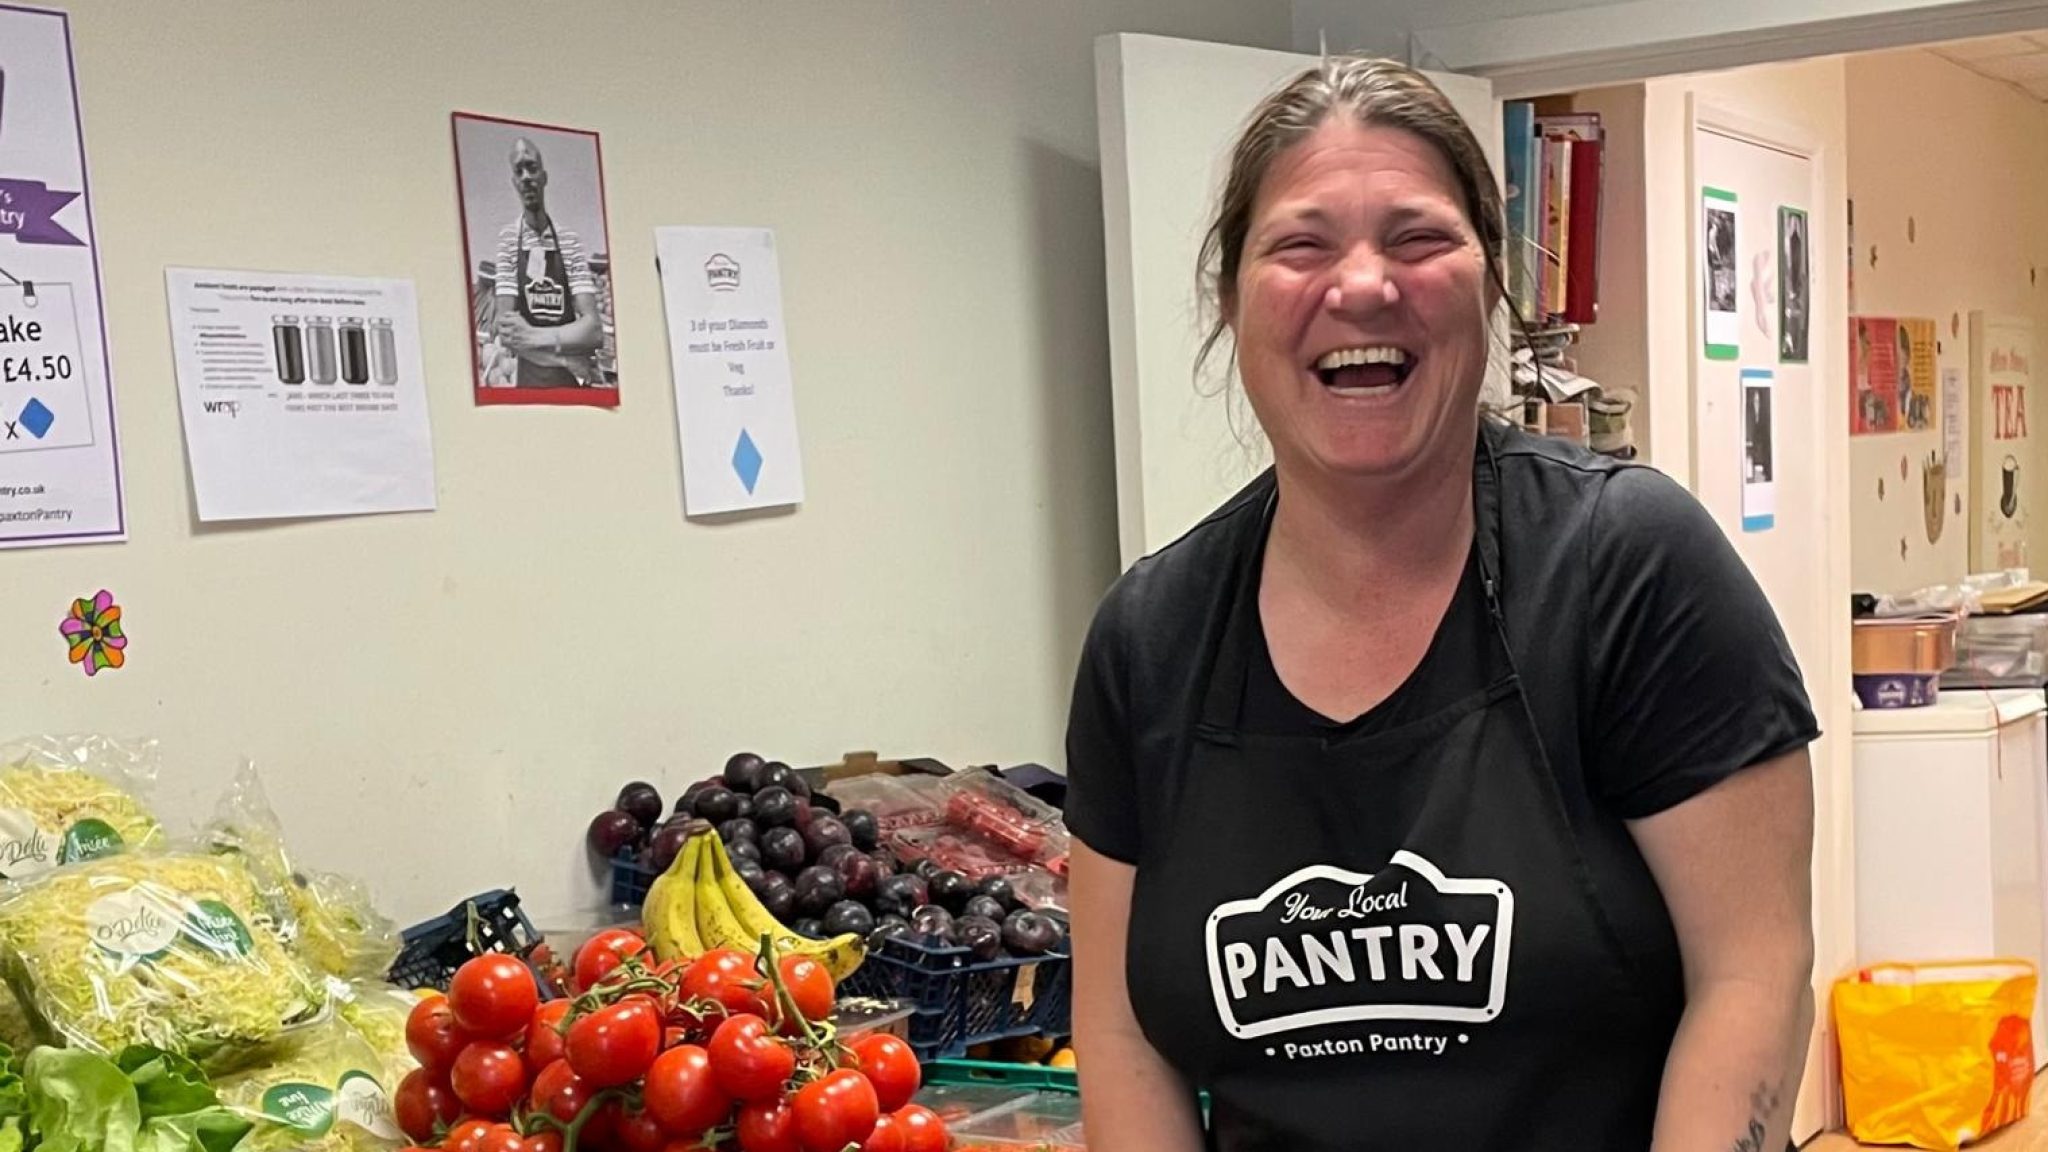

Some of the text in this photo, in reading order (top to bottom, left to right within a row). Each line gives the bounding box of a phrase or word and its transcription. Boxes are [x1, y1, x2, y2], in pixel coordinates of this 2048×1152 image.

[4, 355, 72, 383] £4.50
[1992, 385, 2028, 440] TEA
[1279, 881, 1408, 924] Your Local
[1224, 923, 1491, 1000] PANTRY
[1284, 1033, 1448, 1060] Paxton Pantry
